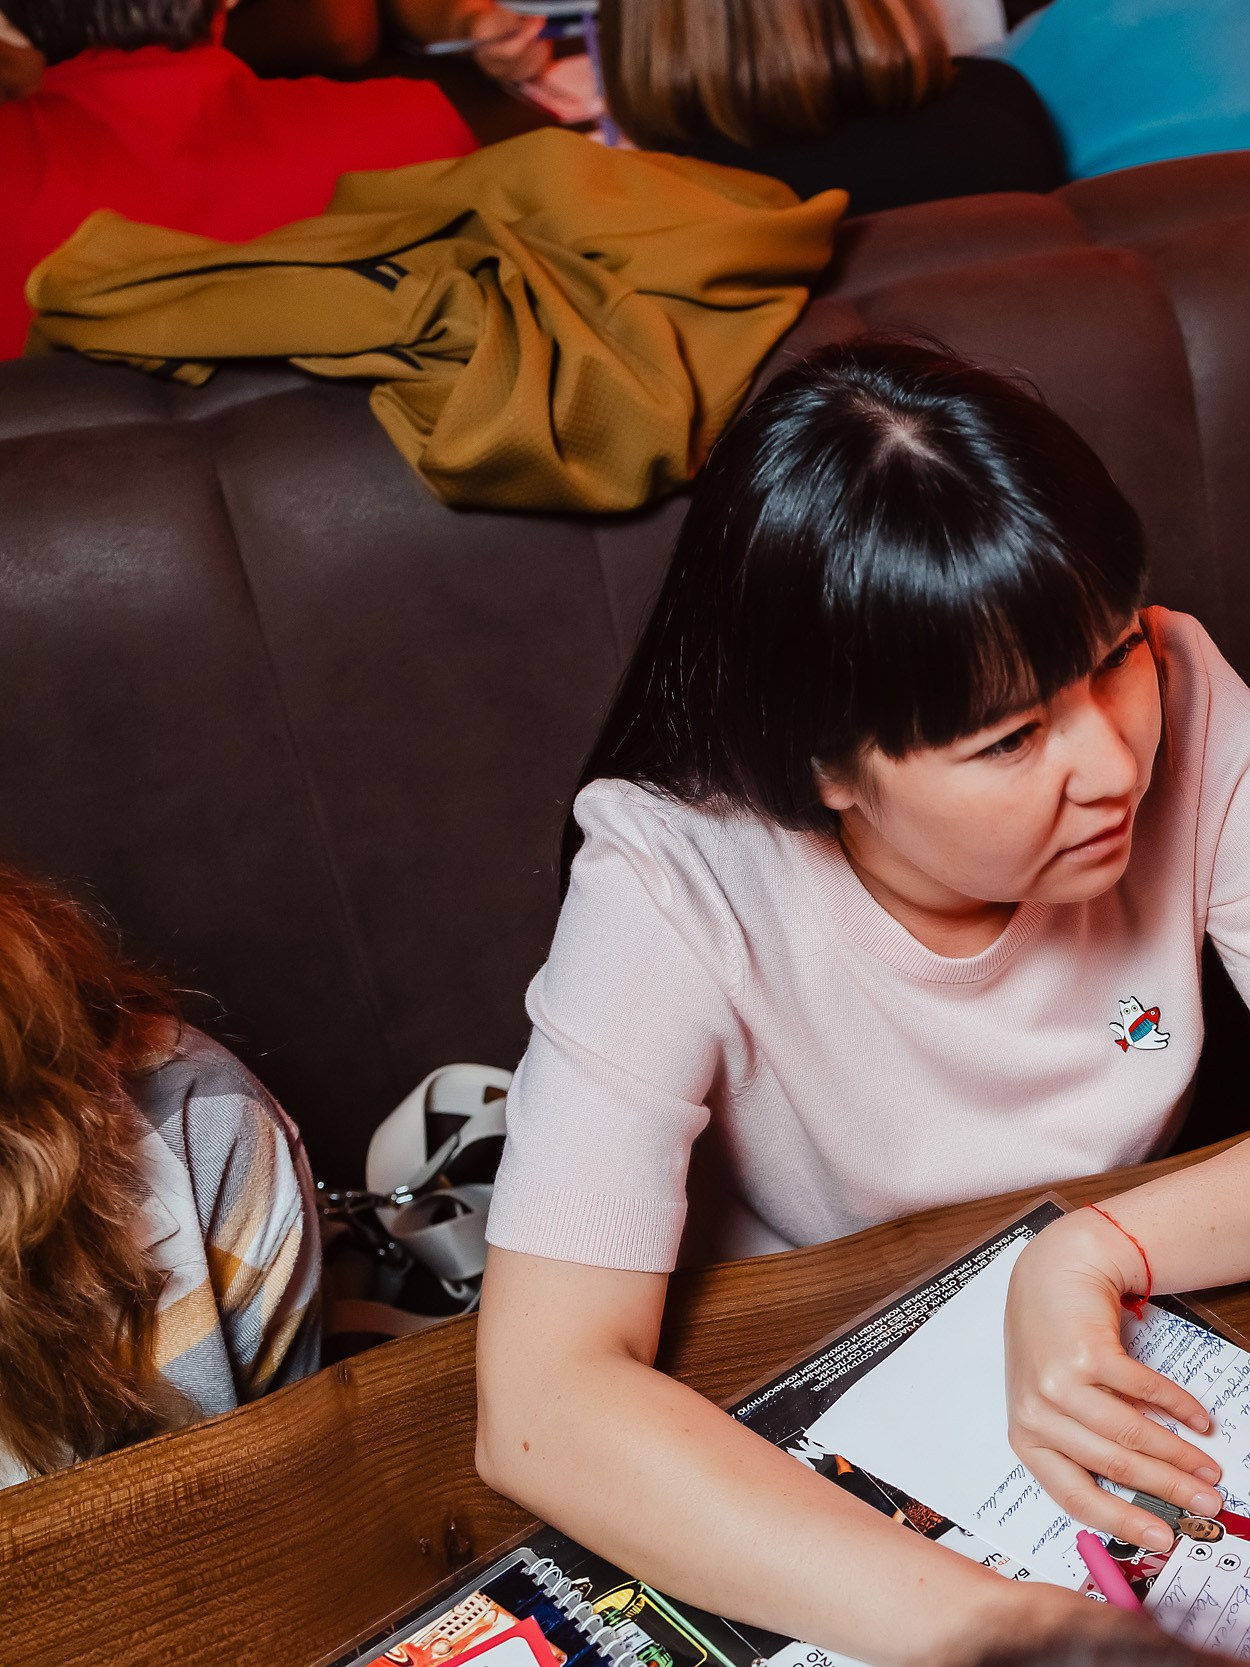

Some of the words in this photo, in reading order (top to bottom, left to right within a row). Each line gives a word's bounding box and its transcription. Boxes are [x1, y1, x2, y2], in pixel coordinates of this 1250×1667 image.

[1012, 1223, 1027, 1236] МЫ
[971, 1233, 1013, 1263] УВАЖАЕМ
[938, 1259, 972, 1284] ЛИЧНЫЕ
[955, 1258, 987, 1281] ВПРАВЕ
[899, 1281, 939, 1309] ГРАНИЦЫ
[904, 1278, 956, 1315] ОТКАЗАТЬСЯ
[929, 1295, 942, 1306] ИХ
[941, 1284, 960, 1299] ПРИ
[856, 1306, 900, 1337] КОМАНДЫ
[860, 1304, 929, 1352] ДОБРОВОЛЬНОМ
[886, 1312, 905, 1326] БЕЗ
[918, 1314, 926, 1323] С
[832, 1323, 888, 1362] ОБЪЯСНЕНИЯ
[872, 1320, 918, 1353] УЧАСТИЕМ
[798, 1339, 850, 1375] СОХРАНЯЕМ
[736, 1371, 800, 1416] КОМФОРТНУЮ
[1195, 1548, 1207, 1556] 6
[1223, 1557, 1236, 1567] 5
